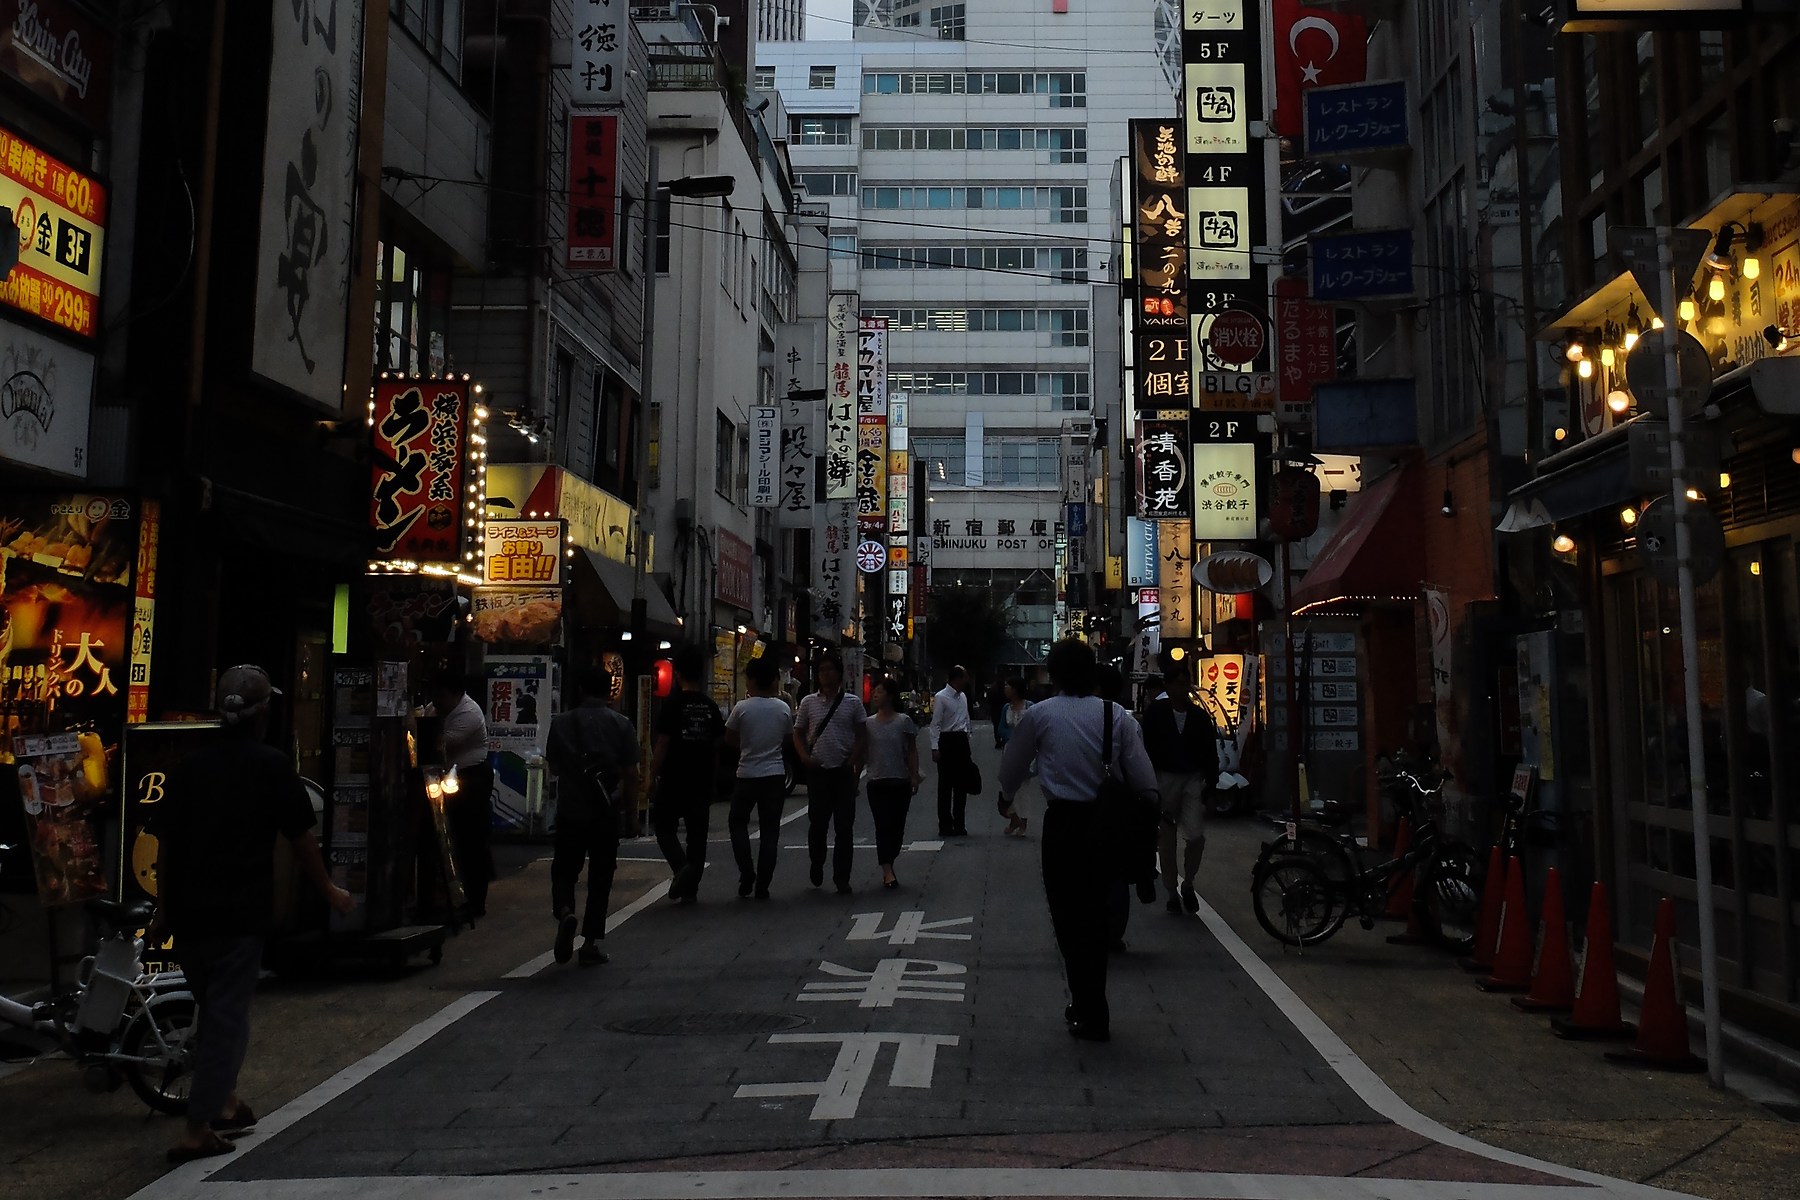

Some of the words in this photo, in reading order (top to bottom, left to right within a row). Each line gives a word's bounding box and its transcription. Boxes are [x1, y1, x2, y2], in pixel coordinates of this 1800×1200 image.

[1191, 10, 1236, 25] ダーツ
[1202, 92, 1232, 116] 牛角
[1320, 96, 1394, 117] レストラン
[35, 209, 53, 257] 金
[65, 227, 85, 267] 3F
[1204, 217, 1235, 241] 牛角
[1325, 244, 1400, 262] レストラン
[1143, 317, 1188, 327] YAKIC
[1213, 327, 1259, 348] 消火栓
[1282, 297, 1303, 385] だるまや
[858, 330, 876, 413] アカマル屋
[1204, 375, 1252, 394] BLG
[426, 391, 461, 501] 横浜家系
[857, 448, 881, 514] 金の蔵
[1150, 431, 1179, 511] 清香苑
[755, 495, 773, 504] 2F
[1201, 499, 1251, 511] 渋谷餃子
[487, 525, 560, 541] ライス&スープ
[501, 539, 545, 557] お替り
[933, 538, 988, 550] SHINJUKU
[997, 539, 1028, 550] POST
[486, 555, 558, 582] 自由!!
[1144, 544, 1154, 584] VALLEY
[1131, 576, 1143, 584] B1
[474, 591, 560, 612] 鉄板ステーキ
[132, 666, 146, 683] 3F
[490, 681, 513, 723] 探偵
[138, 770, 167, 804] B
